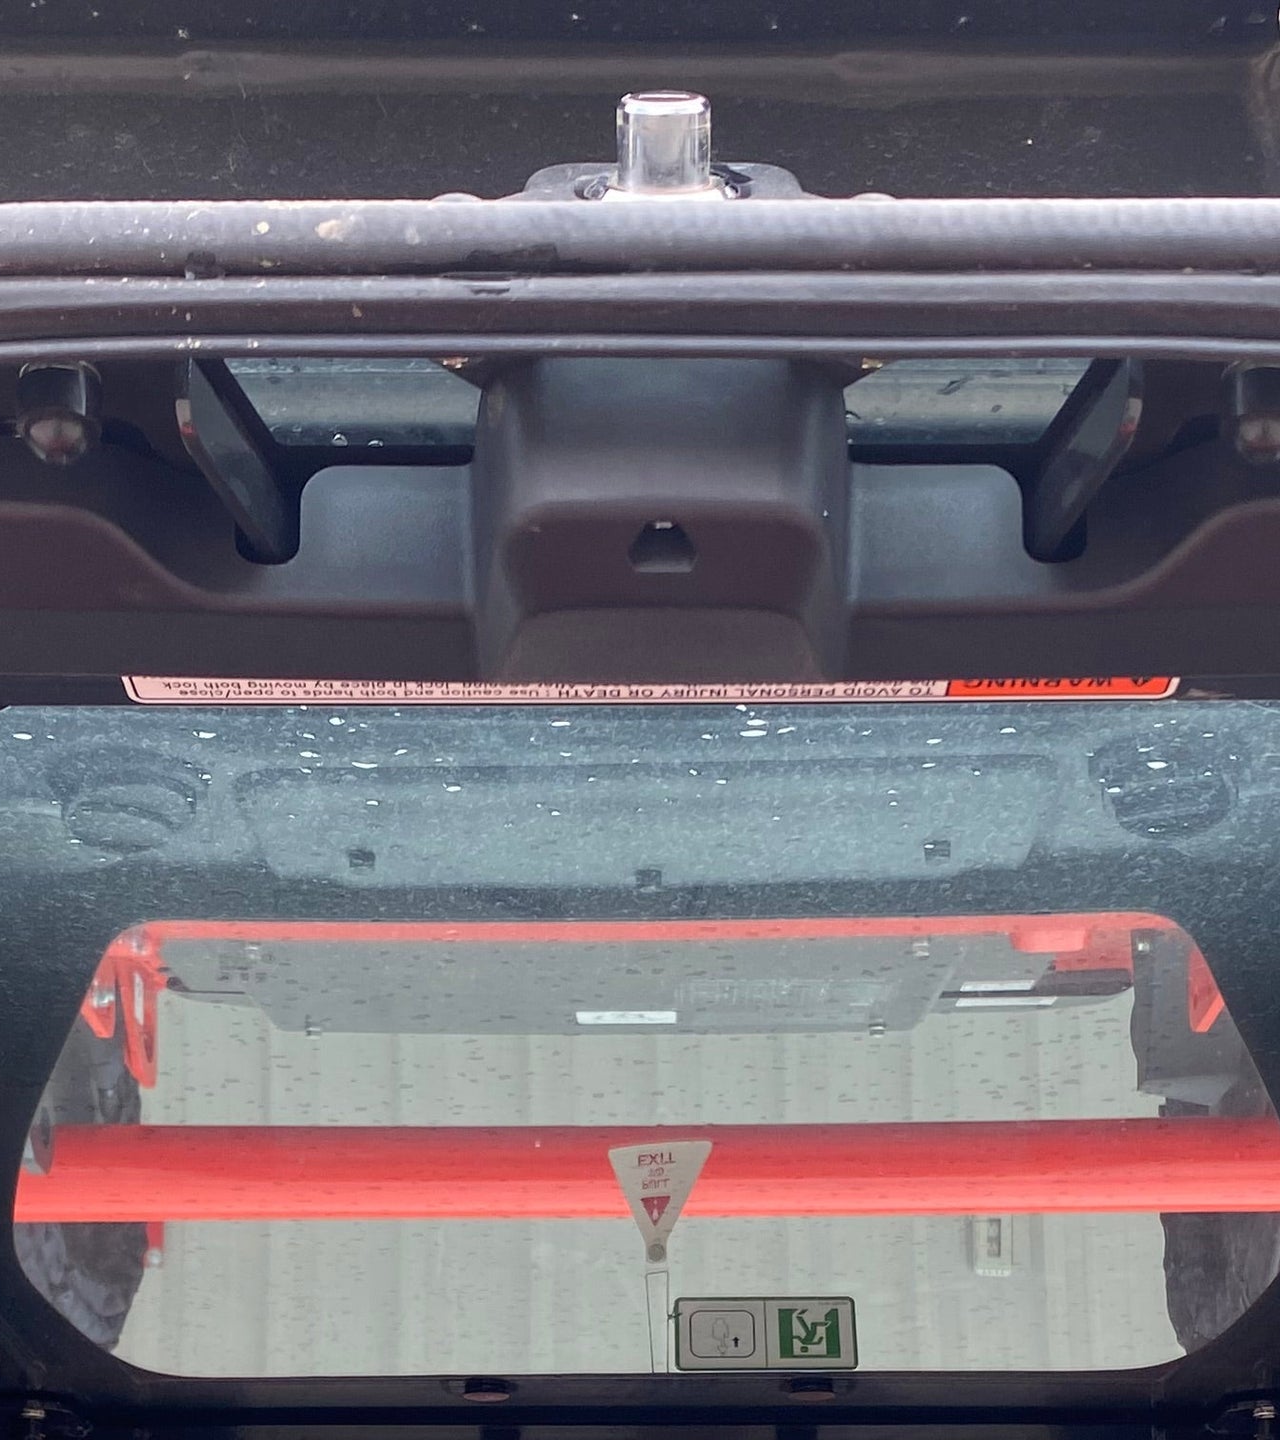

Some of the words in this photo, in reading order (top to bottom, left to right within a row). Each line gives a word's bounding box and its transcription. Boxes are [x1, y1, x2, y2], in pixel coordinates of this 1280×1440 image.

[162, 682, 198, 690] lock
[203, 682, 241, 690] both
[247, 681, 307, 690] moving
[314, 680, 334, 690] by
[340, 681, 386, 689] place
[393, 681, 408, 689] in
[415, 681, 450, 689] lock
[178, 689, 274, 699] open/close
[280, 689, 297, 697] to
[302, 689, 354, 698] hands
[360, 689, 398, 698] both
[403, 689, 434, 698] and
[441, 689, 503, 697] caution
[509, 689, 540, 698] Use
[558, 689, 622, 698] DEATH
[627, 688, 654, 698] OR
[660, 688, 727, 698] INJURY
[734, 688, 836, 698] PERSONAL
[843, 687, 902, 697] AVOID
[910, 687, 934, 696] TO
